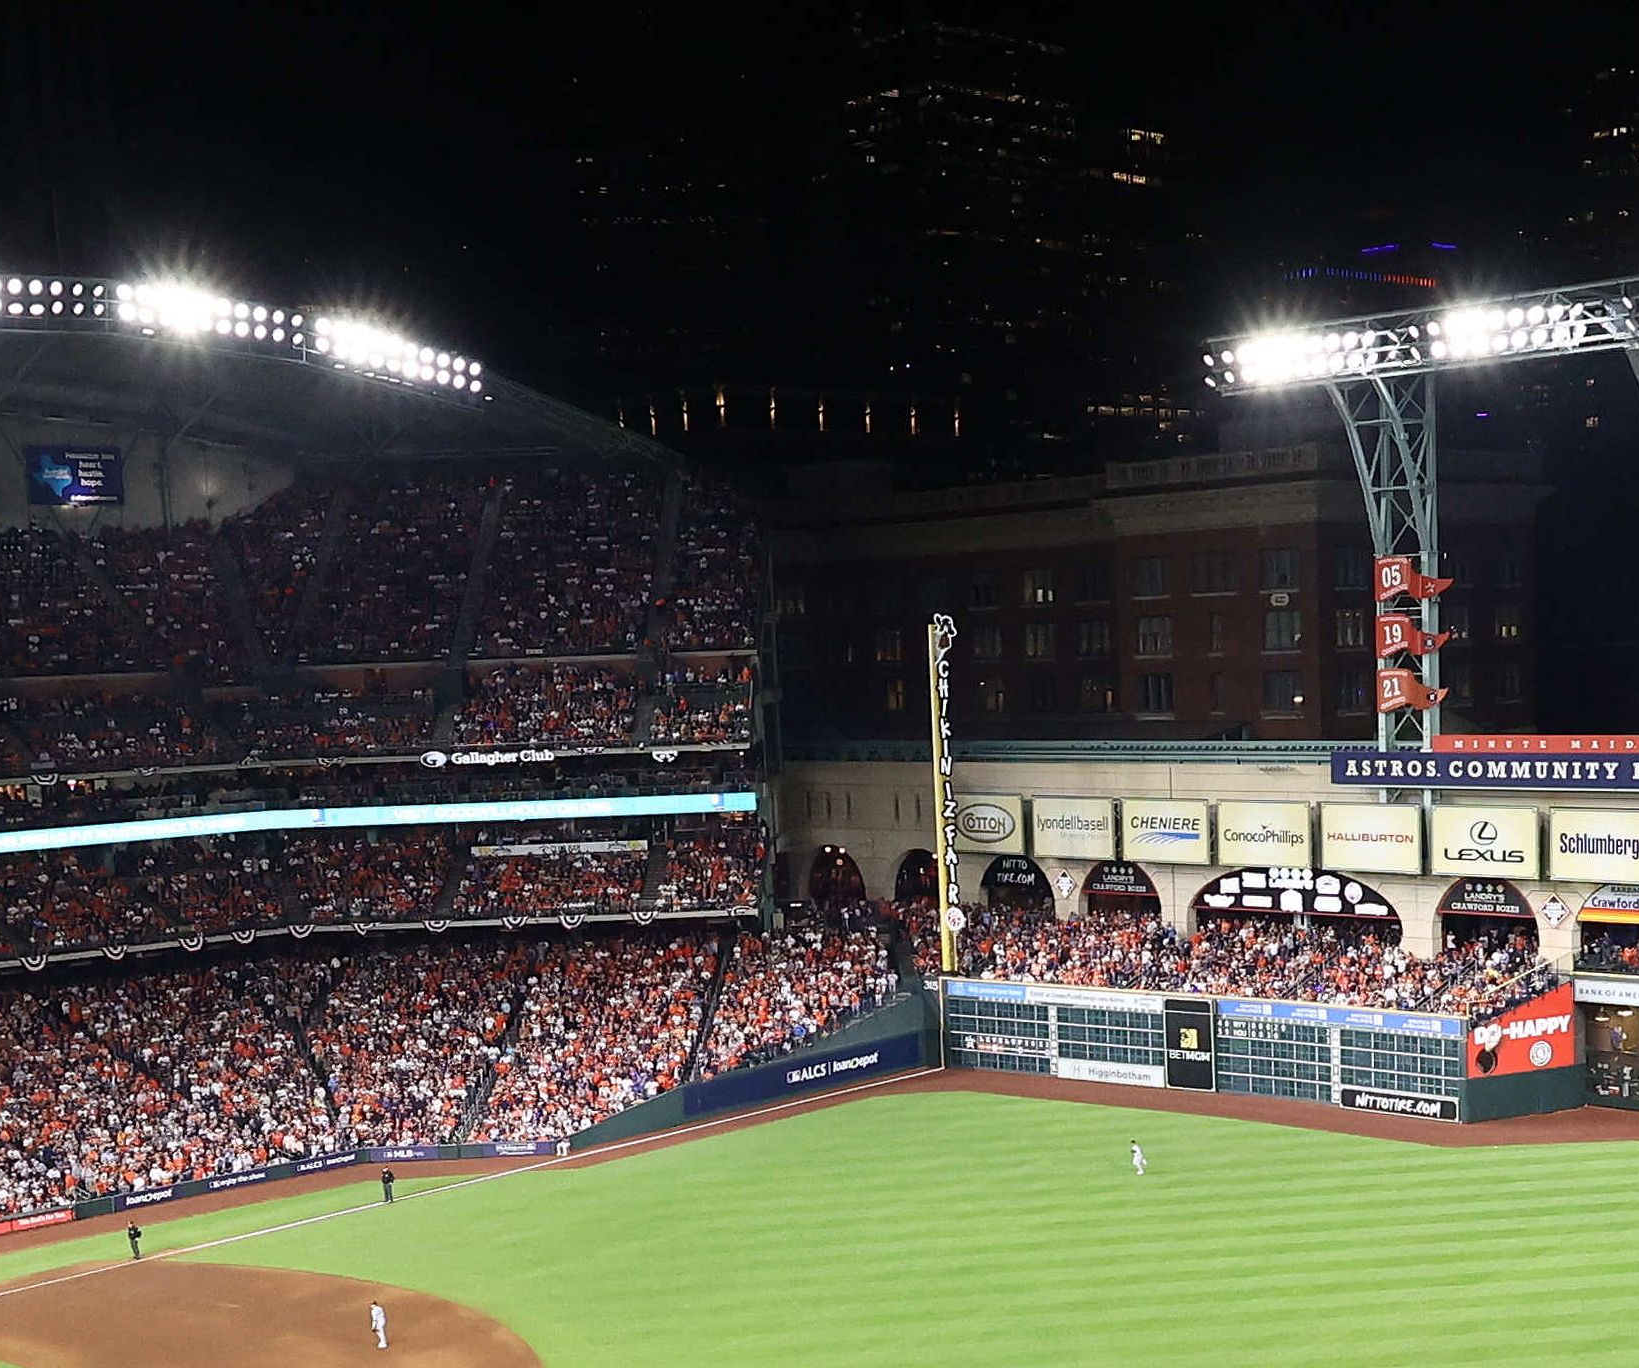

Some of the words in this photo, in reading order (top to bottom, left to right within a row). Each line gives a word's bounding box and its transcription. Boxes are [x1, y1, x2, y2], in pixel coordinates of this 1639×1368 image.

[1382, 564, 1401, 588] 05
[1384, 623, 1402, 645] 19
[1383, 678, 1401, 698] 21
[937, 660, 953, 776] CHIKIN
[1453, 740, 1547, 749] MINUTE
[451, 749, 518, 765] Gallagher
[520, 748, 554, 762] Club
[1448, 760, 1619, 780] COMMUNITY
[942, 780, 957, 819] IZ
[964, 813, 1007, 835] COTTON
[1037, 813, 1109, 832] lyondellbasell
[1130, 816, 1201, 831] CHENIERE
[1223, 828, 1305, 847] ConocoPhillips
[1327, 832, 1414, 844] HALLIBURTON
[943, 825, 959, 905] FAIR
[1444, 848, 1525, 864] LEXUS
[1464, 892, 1505, 903] LANDRY'S
[1451, 902, 1494, 913] CRAWFORD
[1495, 904, 1520, 914] BOXES
[1579, 988, 1603, 998] BANK
[1605, 989, 1617, 998] OF
[1169, 1050, 1210, 1062] BETMGM
[800, 1062, 827, 1082] ALCS
[832, 1050, 879, 1075] loanDepot
[1088, 1067, 1151, 1081] Higginbotham
[1355, 1093, 1441, 1118] NITTOTIRE.COM
[125, 1189, 172, 1206] loanDepot
